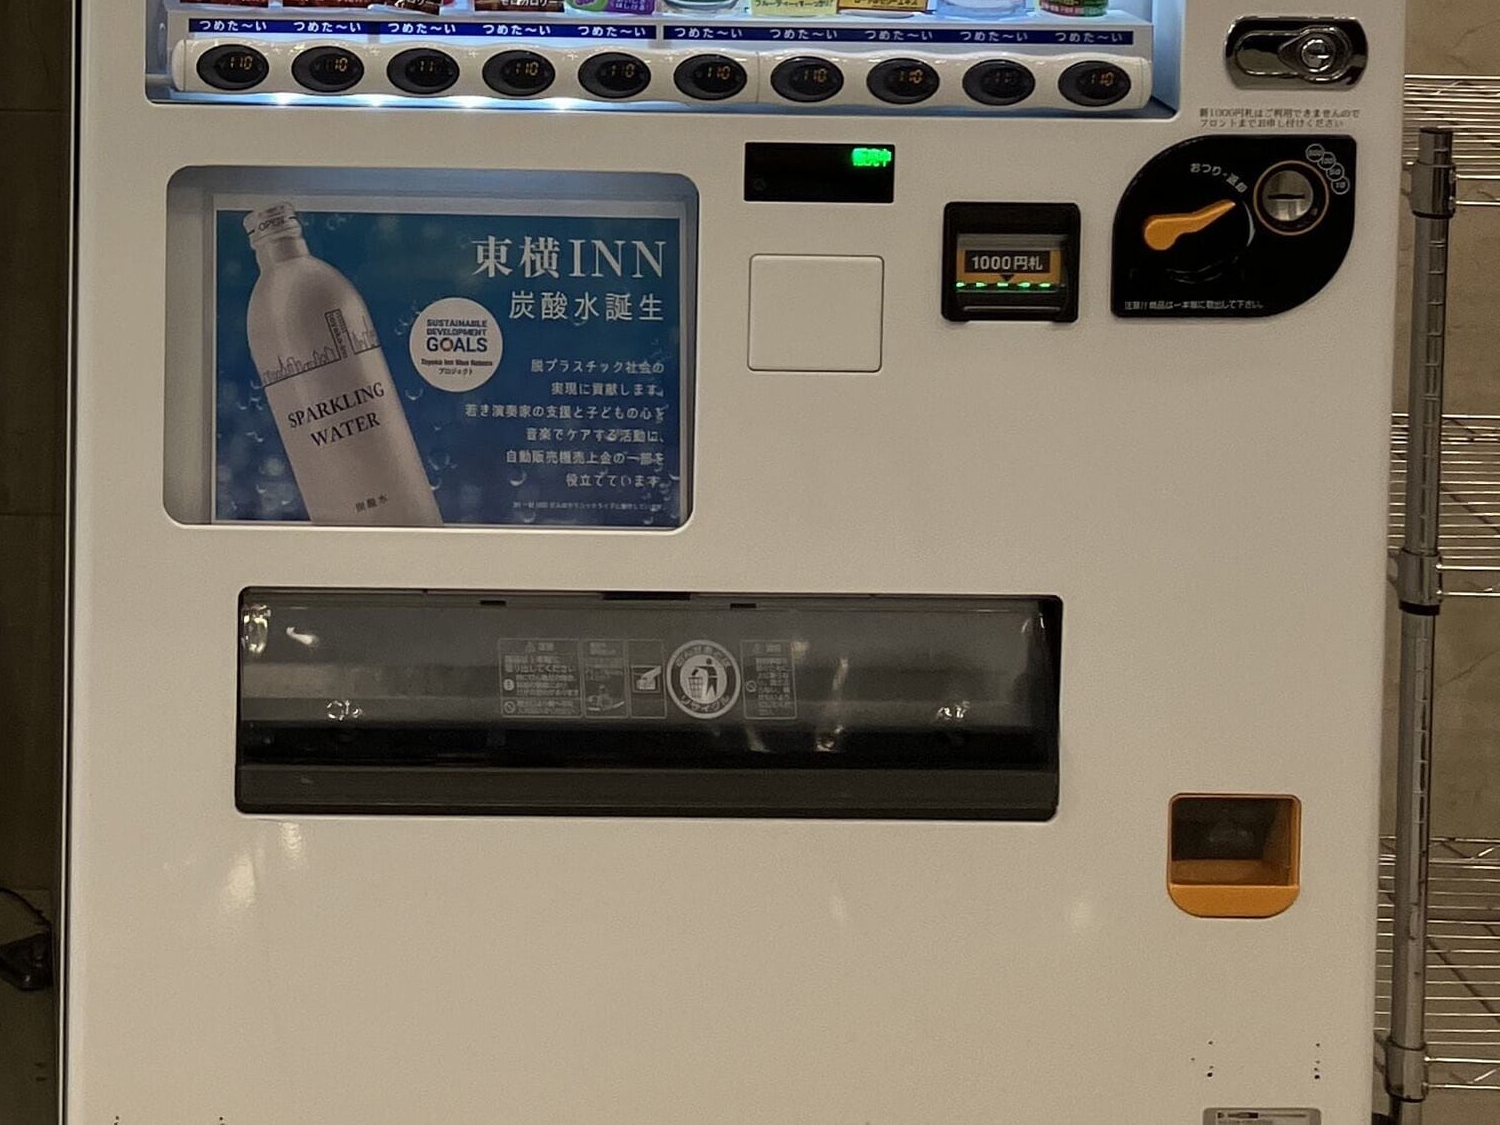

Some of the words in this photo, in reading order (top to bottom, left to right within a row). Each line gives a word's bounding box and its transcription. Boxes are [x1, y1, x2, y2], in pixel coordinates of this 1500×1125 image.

[471, 235, 668, 279] 東横INN
[971, 255, 1044, 273] 1000円札
[509, 291, 665, 322] 炭酸水誕生
[427, 337, 487, 353] GOALS
[288, 381, 385, 430] SPARKLING
[311, 412, 381, 448] WATER
